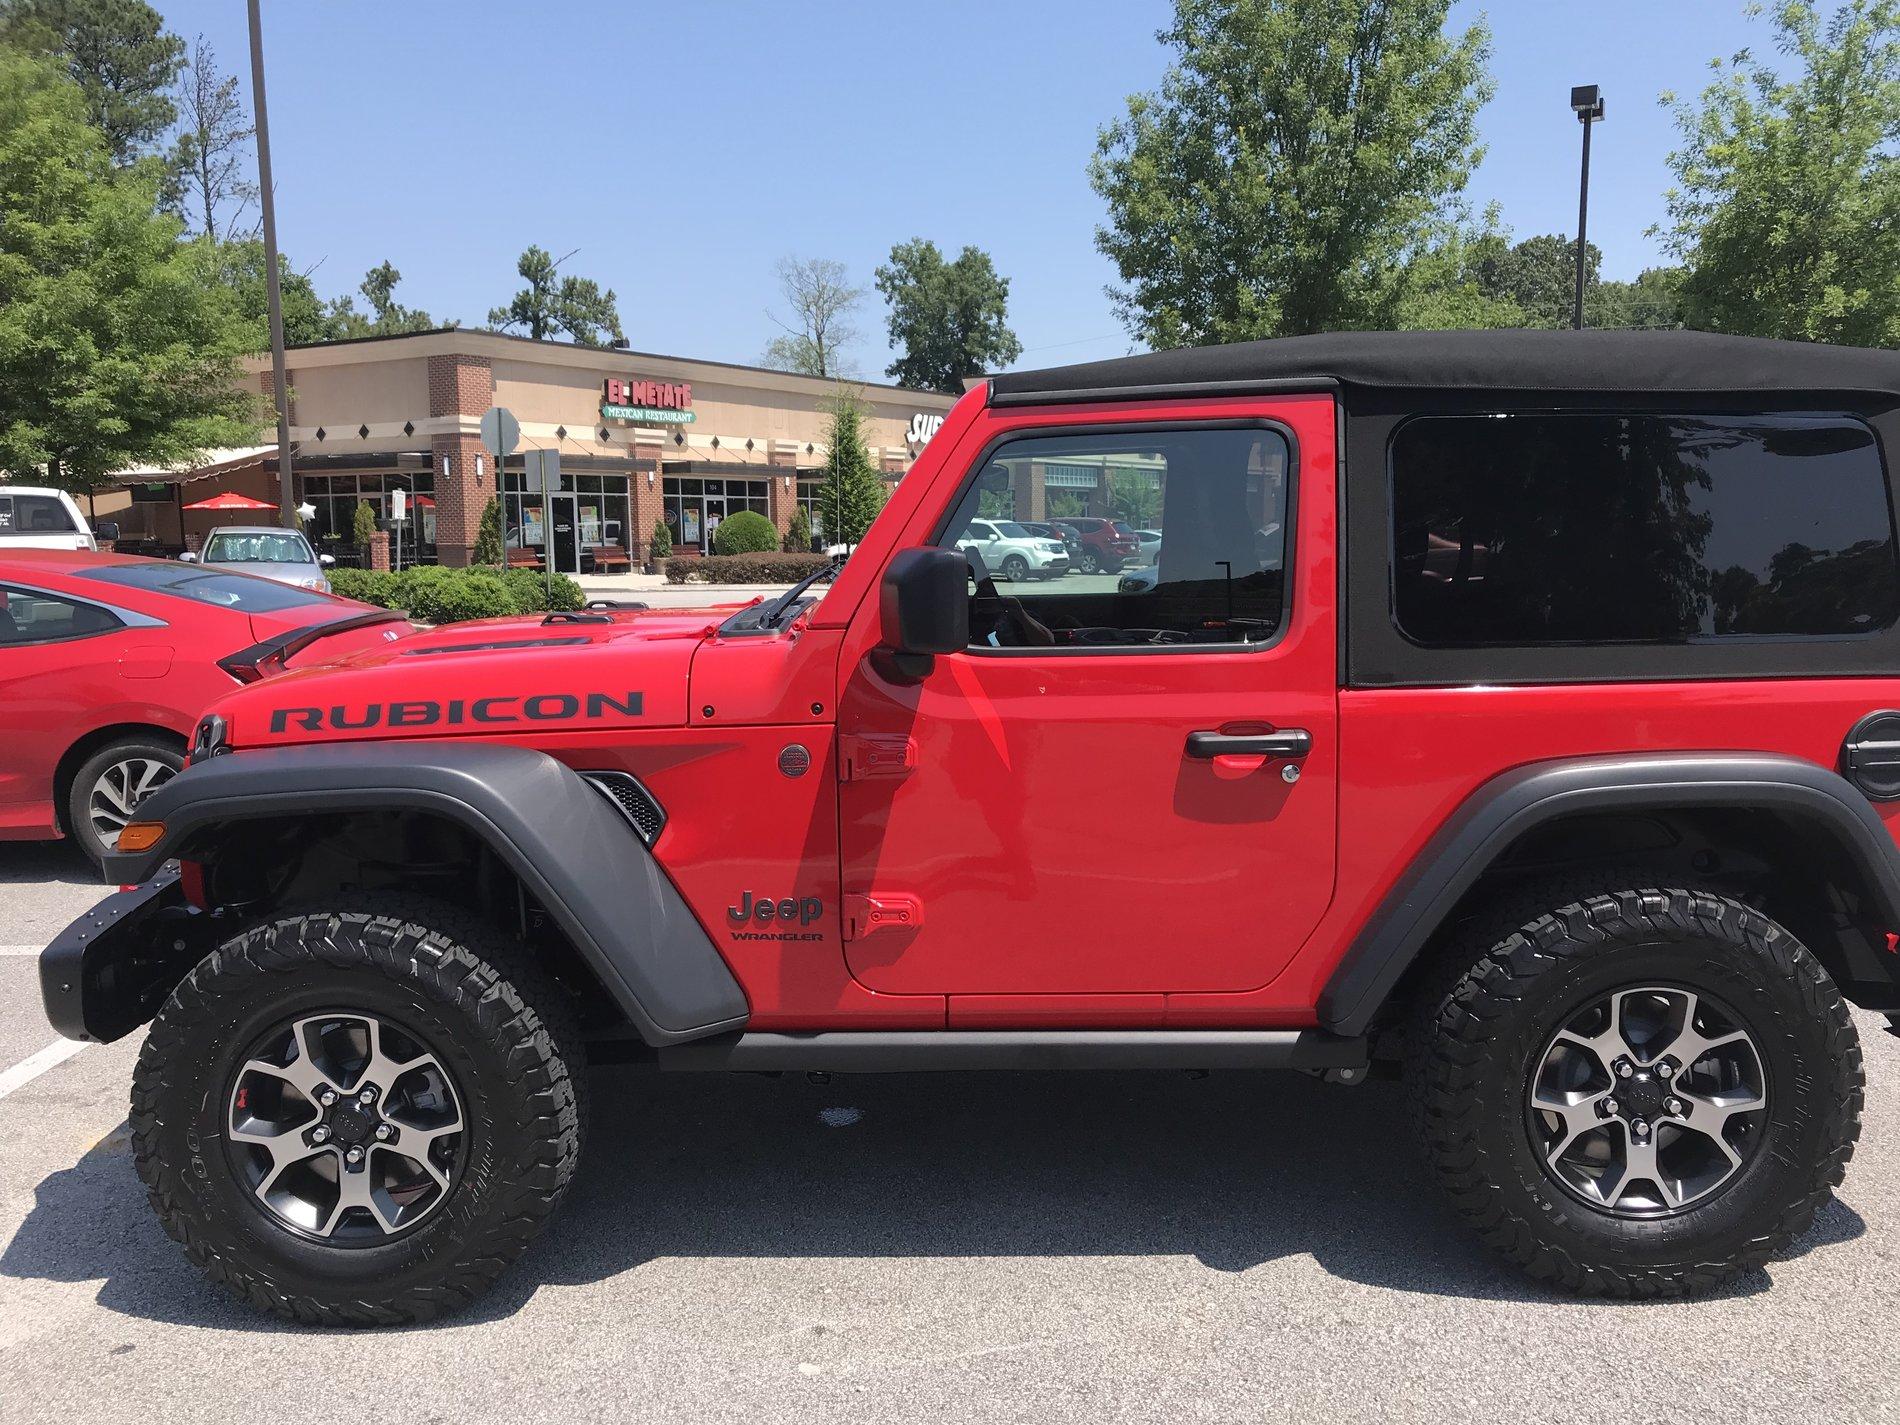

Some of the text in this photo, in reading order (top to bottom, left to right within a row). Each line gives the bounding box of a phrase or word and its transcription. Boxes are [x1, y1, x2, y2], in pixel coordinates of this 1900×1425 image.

[606, 379, 692, 409] EL METATE
[608, 407, 692, 422] MEXICAN RESTAURANT
[270, 691, 644, 733] RUBICON
[727, 890, 823, 926] Jeep
[731, 932, 824, 941] WRANGLER
